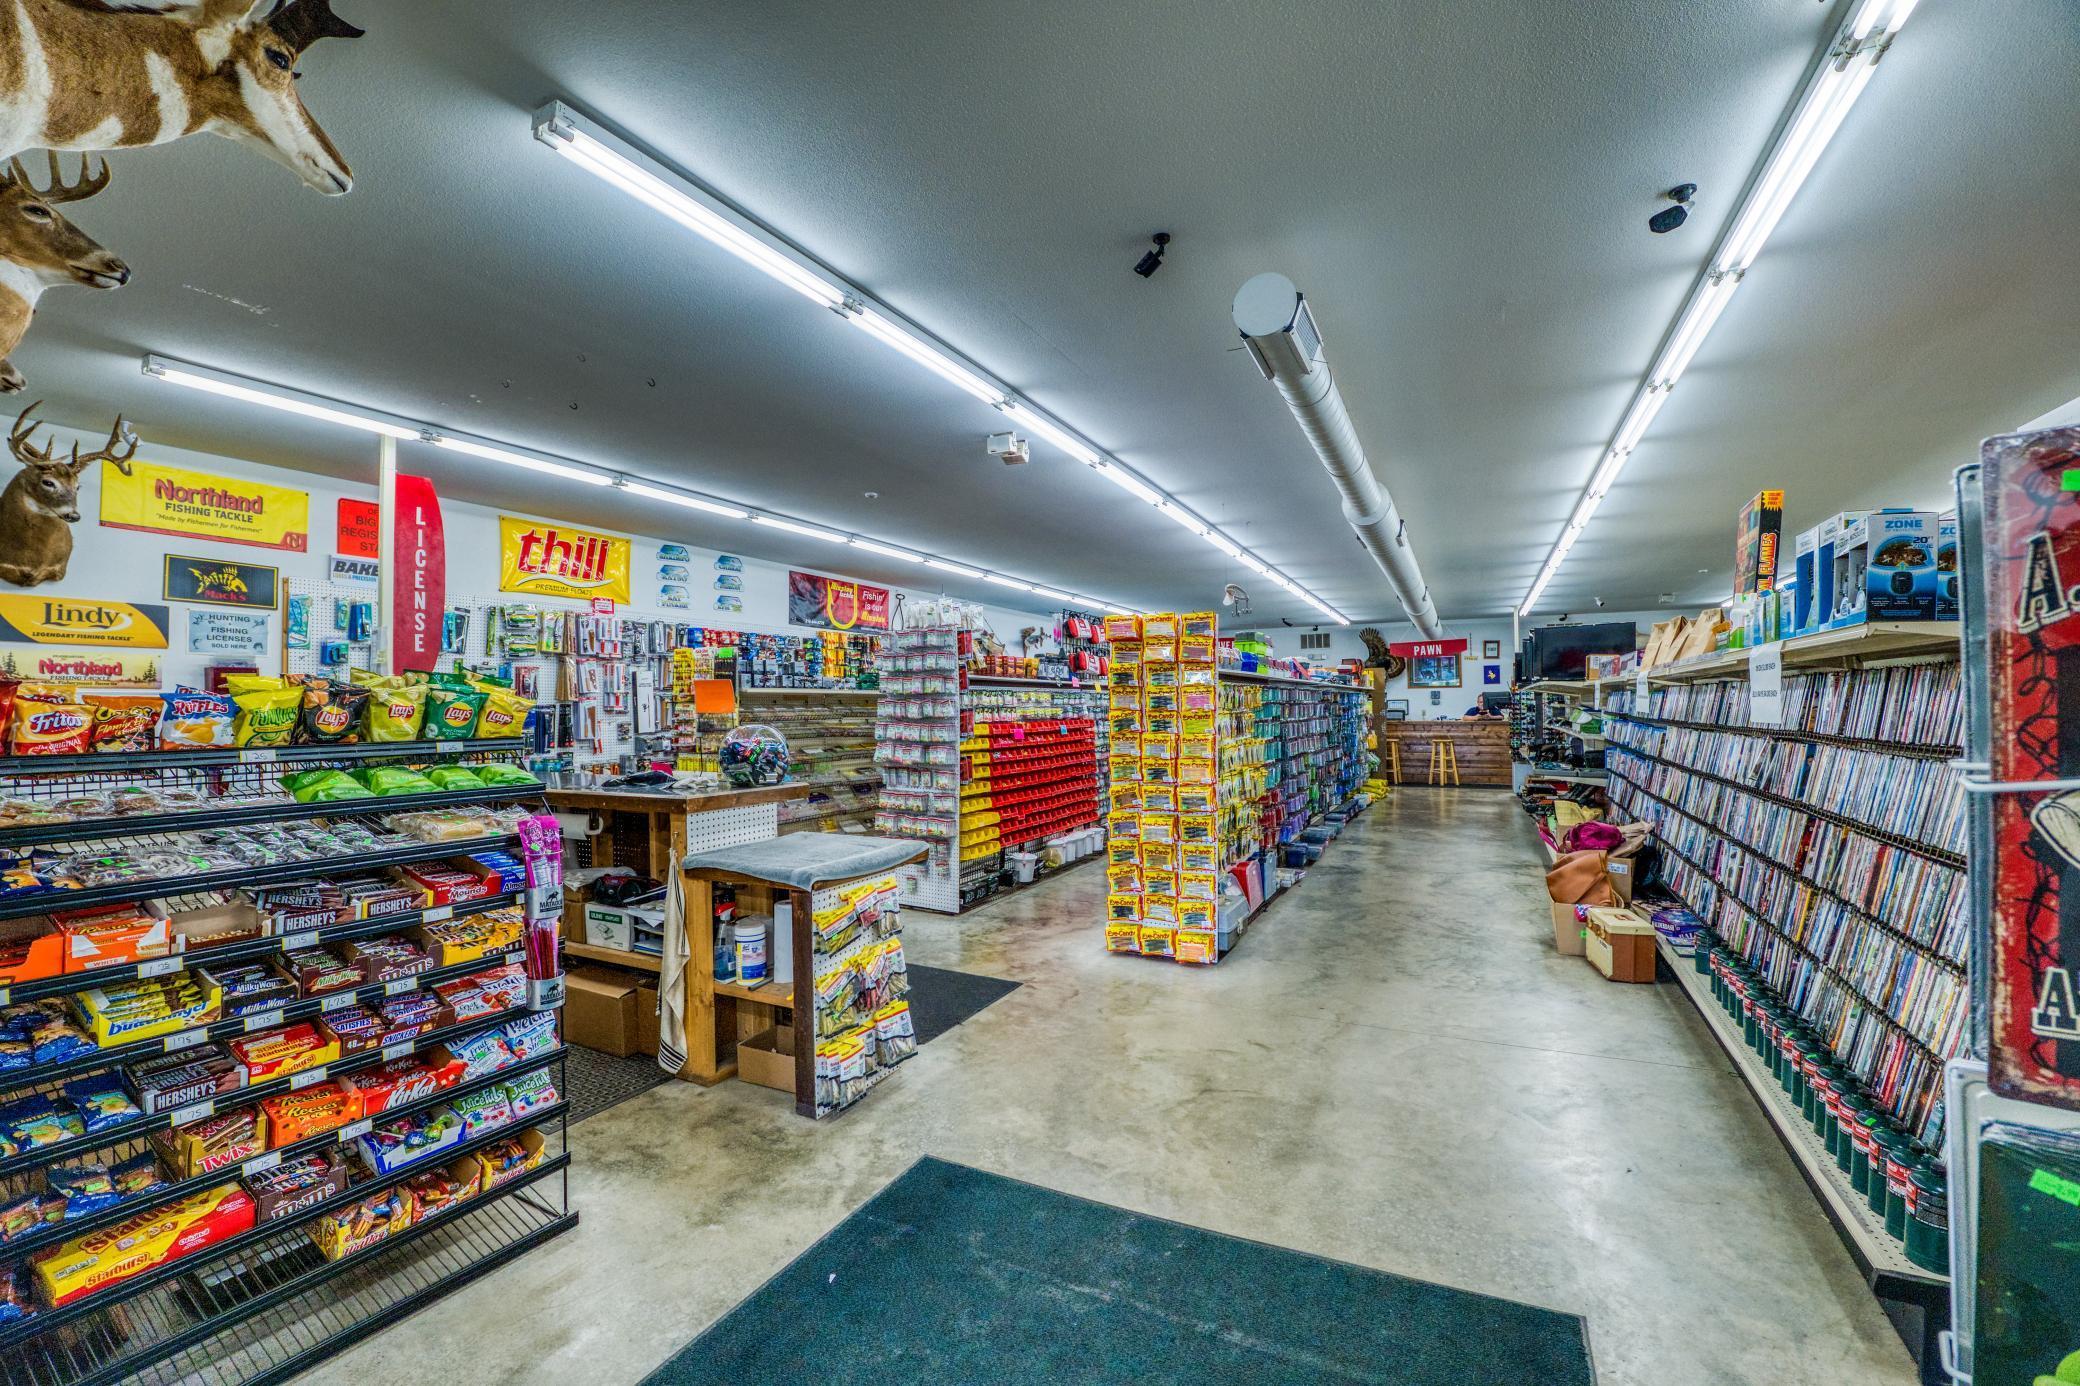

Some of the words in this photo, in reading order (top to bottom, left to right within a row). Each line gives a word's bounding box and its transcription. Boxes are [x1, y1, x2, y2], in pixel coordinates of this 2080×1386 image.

[155, 478, 264, 515] Northland
[165, 502, 211, 517] FISHING
[214, 509, 254, 523] TACKLE
[186, 518, 219, 527] Fishermen
[356, 515, 376, 527] BIG
[1884, 520, 1923, 529] ZONE
[518, 528, 610, 581] thill
[1758, 533, 1777, 575] FLAMES
[414, 506, 427, 653] LICENSE
[535, 583, 569, 593] PREMIUM
[570, 588, 593, 596] FLOATS
[862, 591, 885, 601] Fishin'
[865, 602, 871, 610] is
[872, 604, 883, 612] our
[42, 602, 121, 629] Lindy
[208, 614, 251, 623] HUNTING
[32, 631, 75, 639] LEGENDARY
[206, 634, 253, 643] LICENSES
[211, 626, 248, 635] FISHING
[1413, 644, 1443, 656] PAWN
[39, 658, 123, 676] Northland
[172, 699, 229, 716] RUFFLES
[29, 711, 82, 734] Fritos
[49, 739, 82, 751] ORIGINAL
[450, 887, 487, 900] Mounds
[370, 897, 412, 916] HERSHEY'S
[286, 911, 336, 931] HERSHEY'S
[318, 973, 340, 986] Milky
[340, 970, 359, 980] Way
[335, 1018, 371, 1033] SATISFIES
[382, 1028, 418, 1044] SNICKERS
[470, 1039, 488, 1055] Fruit
[157, 1080, 216, 1110] HERSHEY'S
[86, 1253, 149, 1287] Starburst
